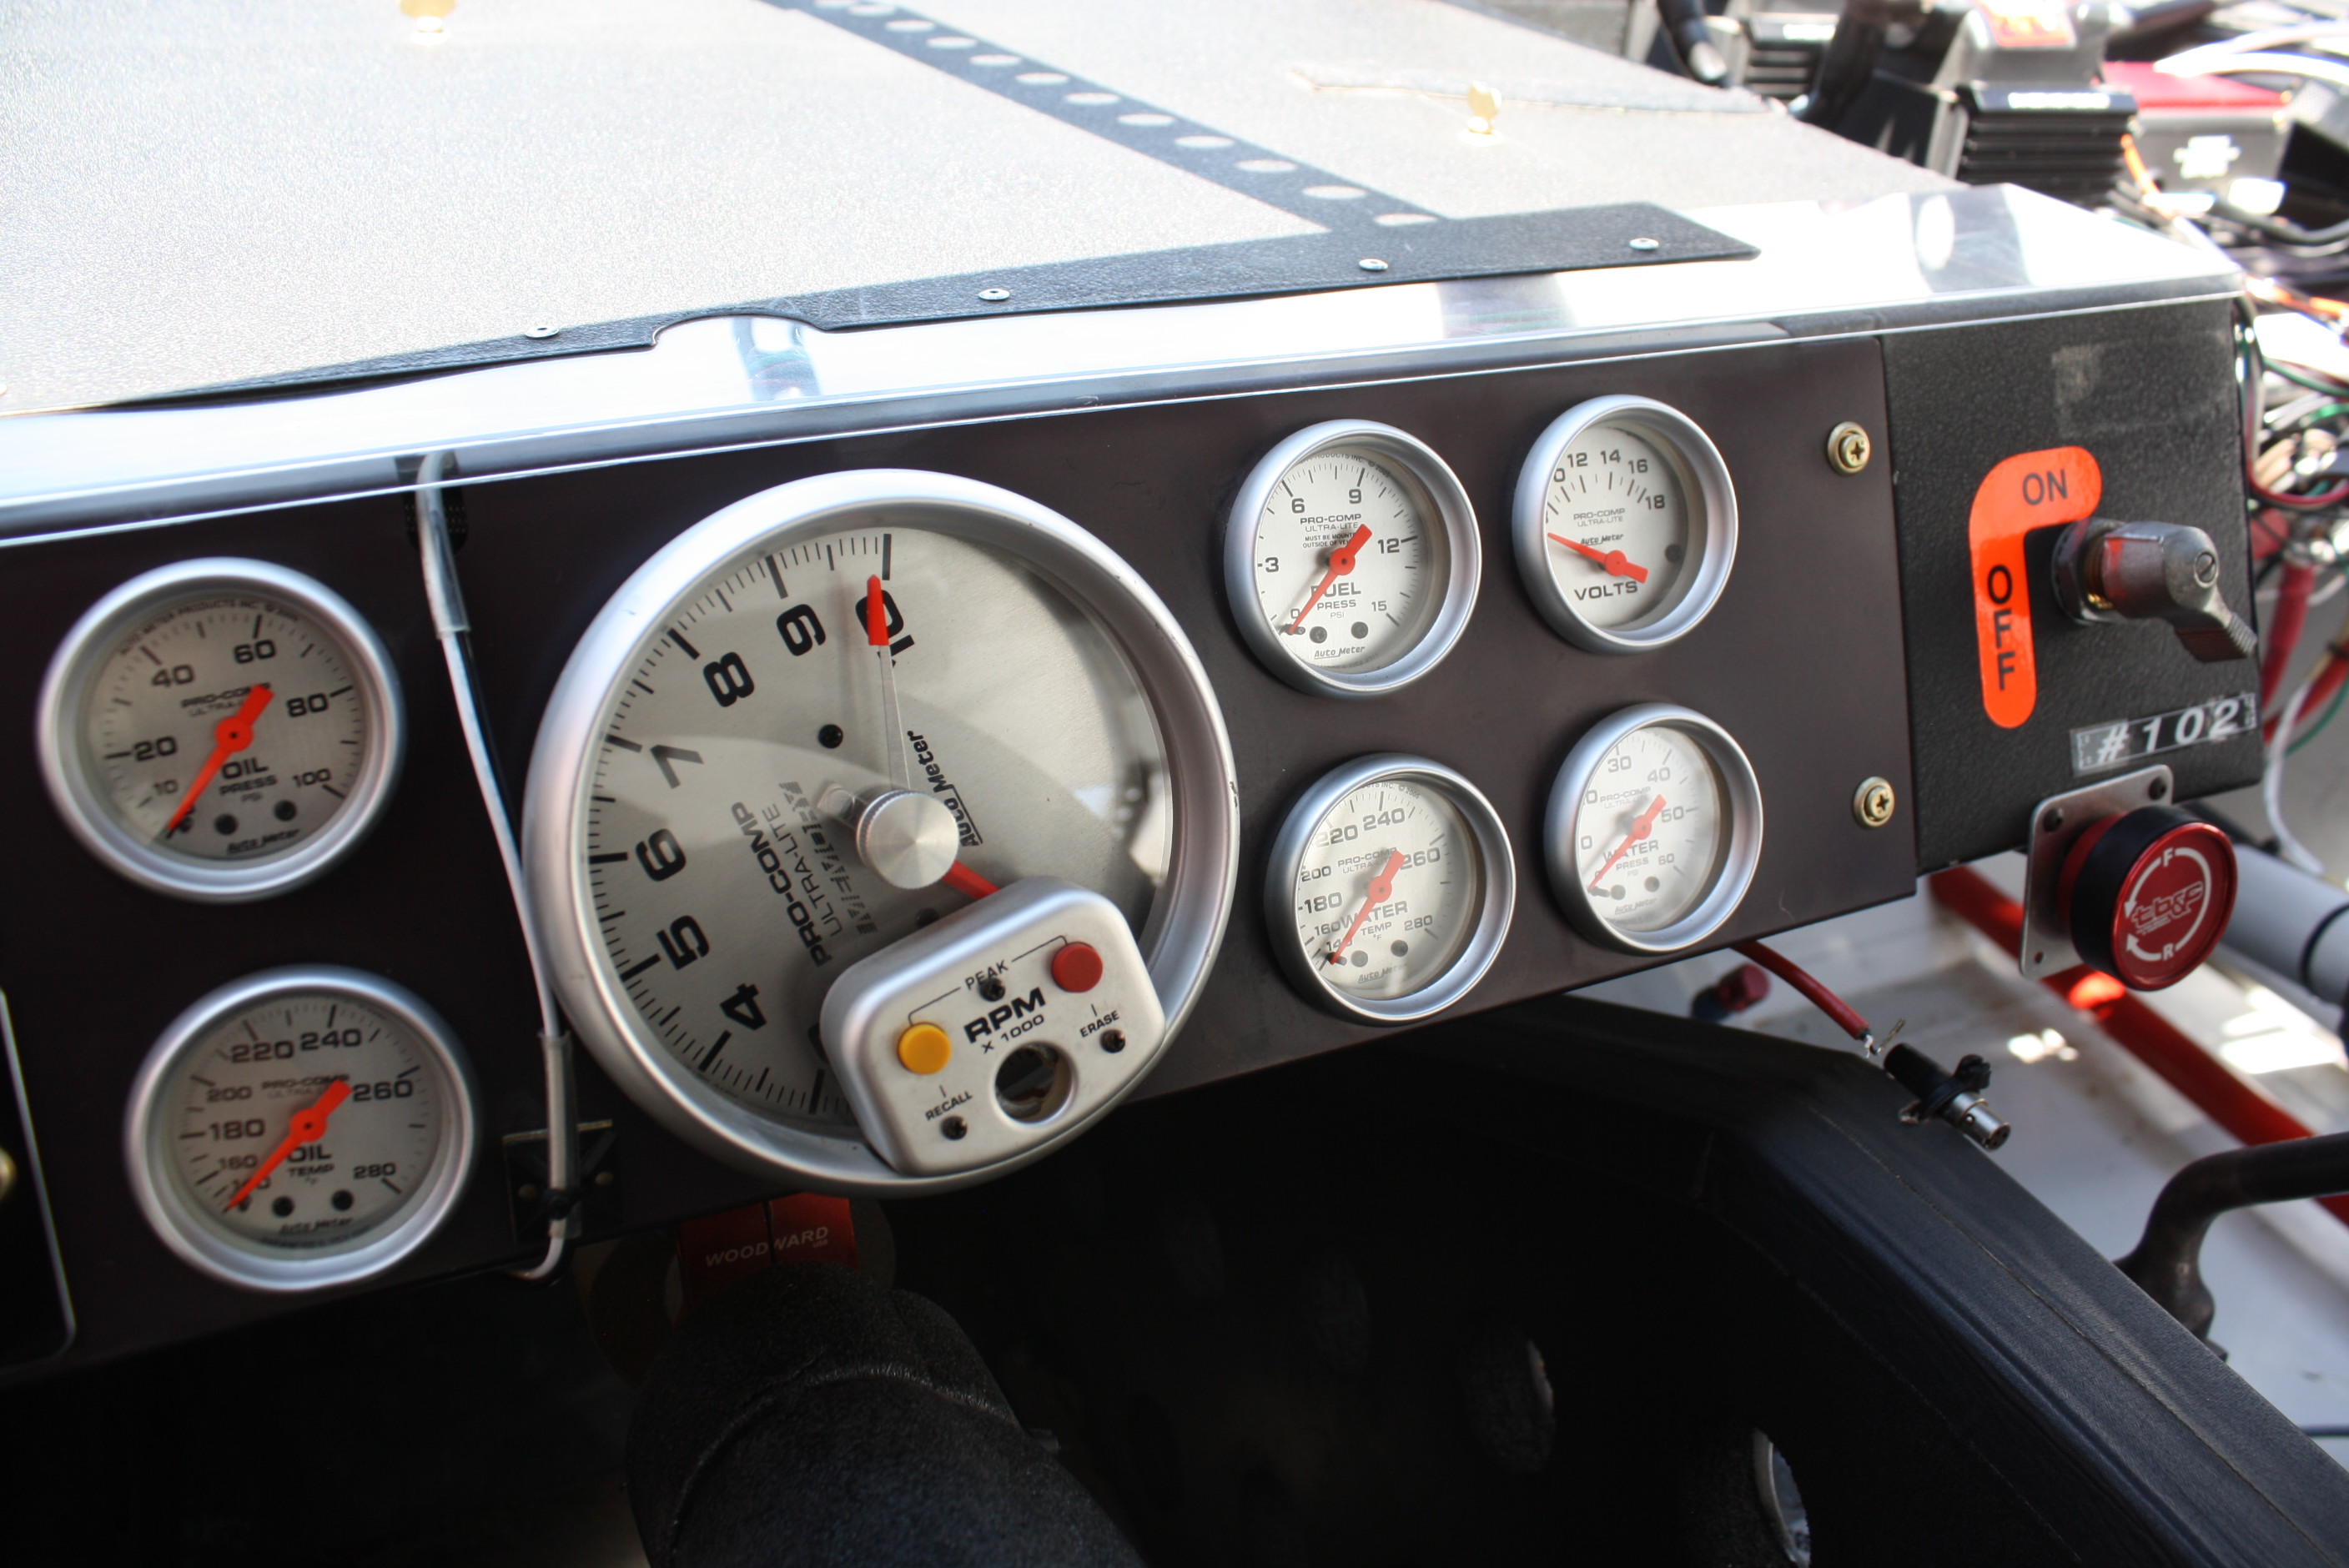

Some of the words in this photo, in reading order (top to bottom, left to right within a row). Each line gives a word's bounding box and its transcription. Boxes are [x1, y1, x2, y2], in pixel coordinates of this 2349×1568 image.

[1567, 452, 1588, 468] 12
[1600, 450, 1621, 465] 14
[1628, 459, 1648, 474] 16
[1348, 488, 1362, 504] 9
[2022, 469, 2069, 505] ON
[1292, 498, 1305, 513] 6
[1645, 494, 1666, 510] 18
[1300, 513, 1361, 525] PRO-COMP
[1573, 508, 1626, 520] PRO-COMP
[1577, 515, 1623, 527] ULTRA-LITE
[1305, 521, 1359, 532] ULTRA-LITE
[1377, 538, 1401, 554] 12
[1581, 537, 1599, 545] Auto
[1601, 534, 1624, 544] Meter
[1265, 557, 1280, 573] 3
[1574, 580, 1637, 601] VOLTS
[1317, 600, 1356, 611] PRESS
[1371, 601, 1387, 611] 15
[776, 604, 826, 656] 9
[1986, 565, 2016, 691] OFF
[234, 640, 277, 664] 60
[1314, 649, 1336, 659] Auto
[1338, 646, 1366, 657] Meter
[151, 665, 195, 687] 40
[702, 651, 755, 707] 8
[286, 693, 329, 717] 80
[2096, 699, 2241, 766] #102
[133, 736, 179, 762] 20
[221, 757, 269, 780] OIL
[650, 744, 704, 789] 7
[907, 730, 955, 793] Meter
[1607, 755, 1632, 773] 30
[293, 768, 332, 788] 100
[1647, 766, 1671, 782] 40
[152, 779, 179, 795] 10
[219, 775, 279, 796] PRESS
[1599, 786, 1652, 802] PRO-COMP
[1363, 808, 1406, 831] 240
[1661, 805, 1685, 823] 50
[1315, 824, 1359, 848] 220
[634, 828, 687, 882] 6
[1337, 847, 1397, 867] PRO-COMP
[1400, 847, 1441, 871] 260
[1616, 857, 1649, 872] PRESS
[1657, 852, 1675, 866] 60
[2162, 847, 2175, 867] F
[762, 803, 843, 937] ULTRA-LITE
[1301, 866, 1332, 882] 200
[730, 801, 832, 967] PRO-COMP
[1305, 892, 1343, 914] 180
[1314, 921, 1340, 936] 160
[1361, 922, 1392, 936] TEMP
[1404, 915, 1433, 932] 280
[655, 915, 711, 971] 5
[2162, 942, 2175, 960] R
[964, 959, 1009, 991] PEAK
[1358, 971, 1379, 983] Auto
[720, 983, 767, 1032] 4
[963, 988, 1047, 1043] RPM
[1000, 1013, 1046, 1043] 1000
[1079, 1010, 1120, 1038] ERASE
[299, 1028, 362, 1052] 240
[230, 1040, 296, 1064] 220
[206, 1086, 254, 1103] 200
[351, 1079, 414, 1103] 260
[924, 1090, 973, 1121] RECALL
[209, 1118, 266, 1141] 180
[218, 1153, 259, 1171] 160
[286, 1143, 332, 1163] OIL
[287, 1163, 335, 1178] TEMP
[352, 1162, 398, 1180] 280
